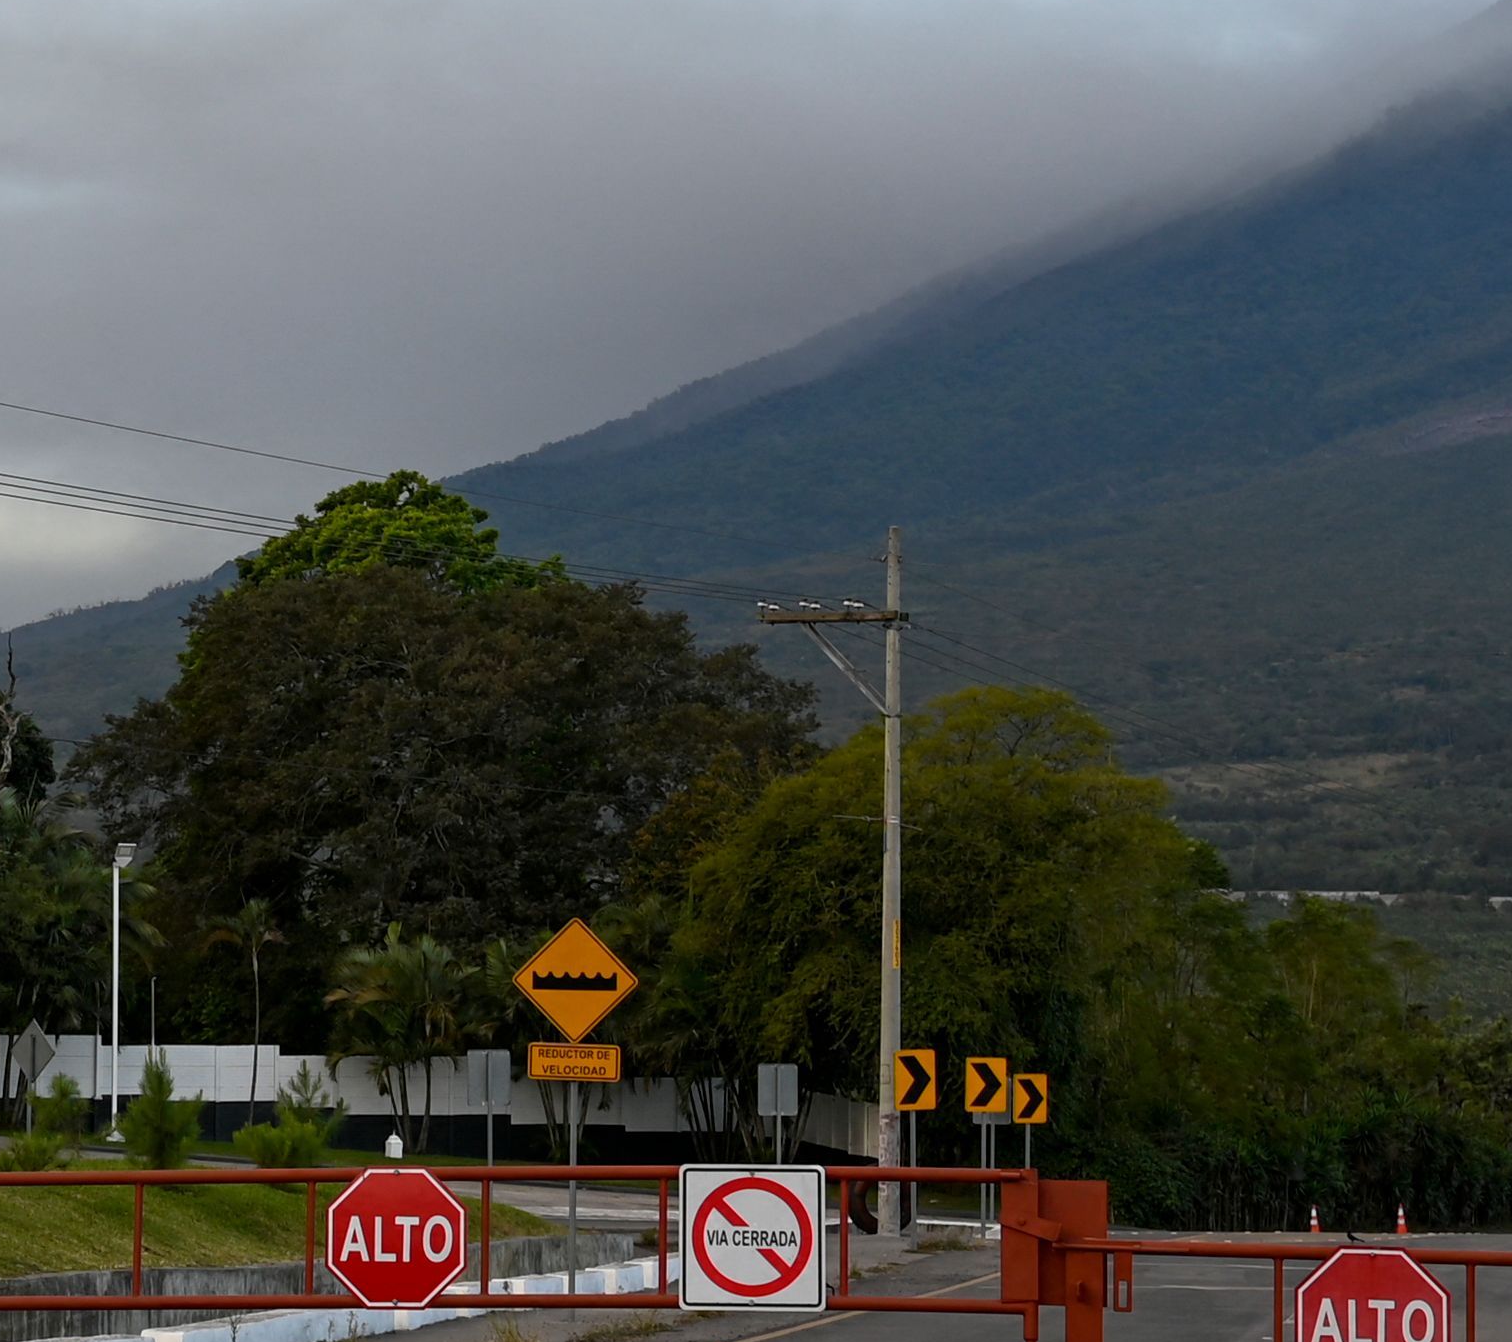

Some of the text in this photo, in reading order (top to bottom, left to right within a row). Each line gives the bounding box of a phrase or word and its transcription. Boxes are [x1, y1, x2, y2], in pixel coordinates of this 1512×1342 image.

[538, 1048, 611, 1061] REDUCTOR DE
[542, 1064, 607, 1076] VELOCIDAD
[340, 1215, 452, 1263] ALTO
[707, 1230, 798, 1248] VIA CERRADA
